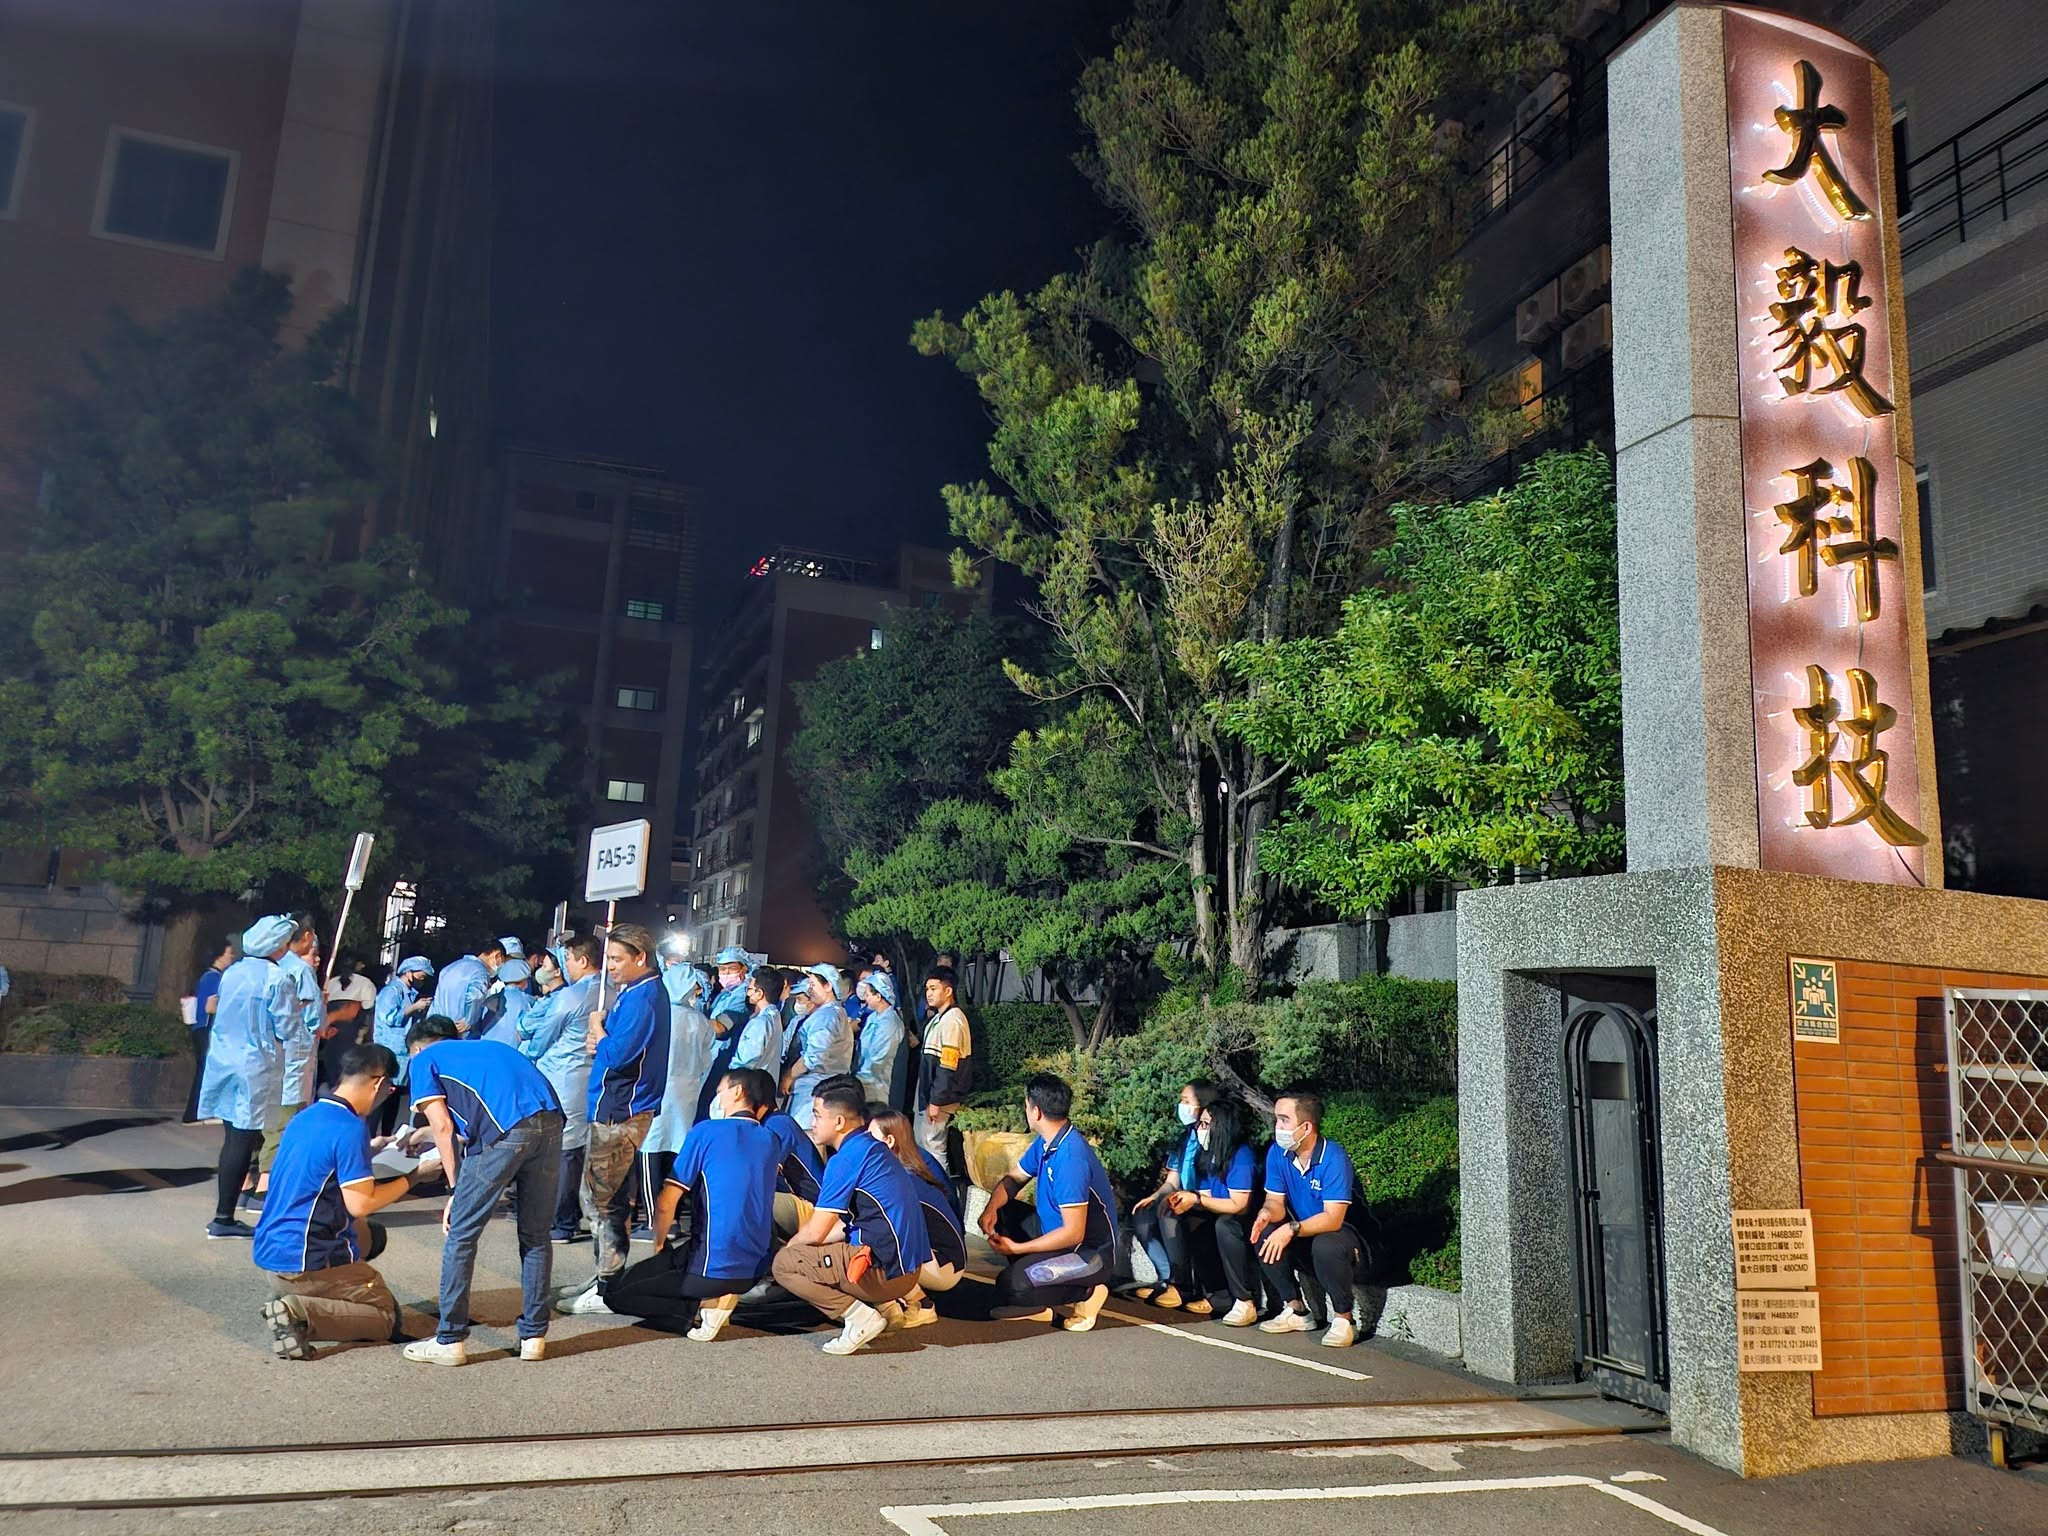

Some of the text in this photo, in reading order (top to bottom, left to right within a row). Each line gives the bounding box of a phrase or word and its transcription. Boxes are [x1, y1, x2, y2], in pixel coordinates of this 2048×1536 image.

[1762, 60, 1929, 847] 大毅科技
[596, 844, 636, 870] FA5-3
